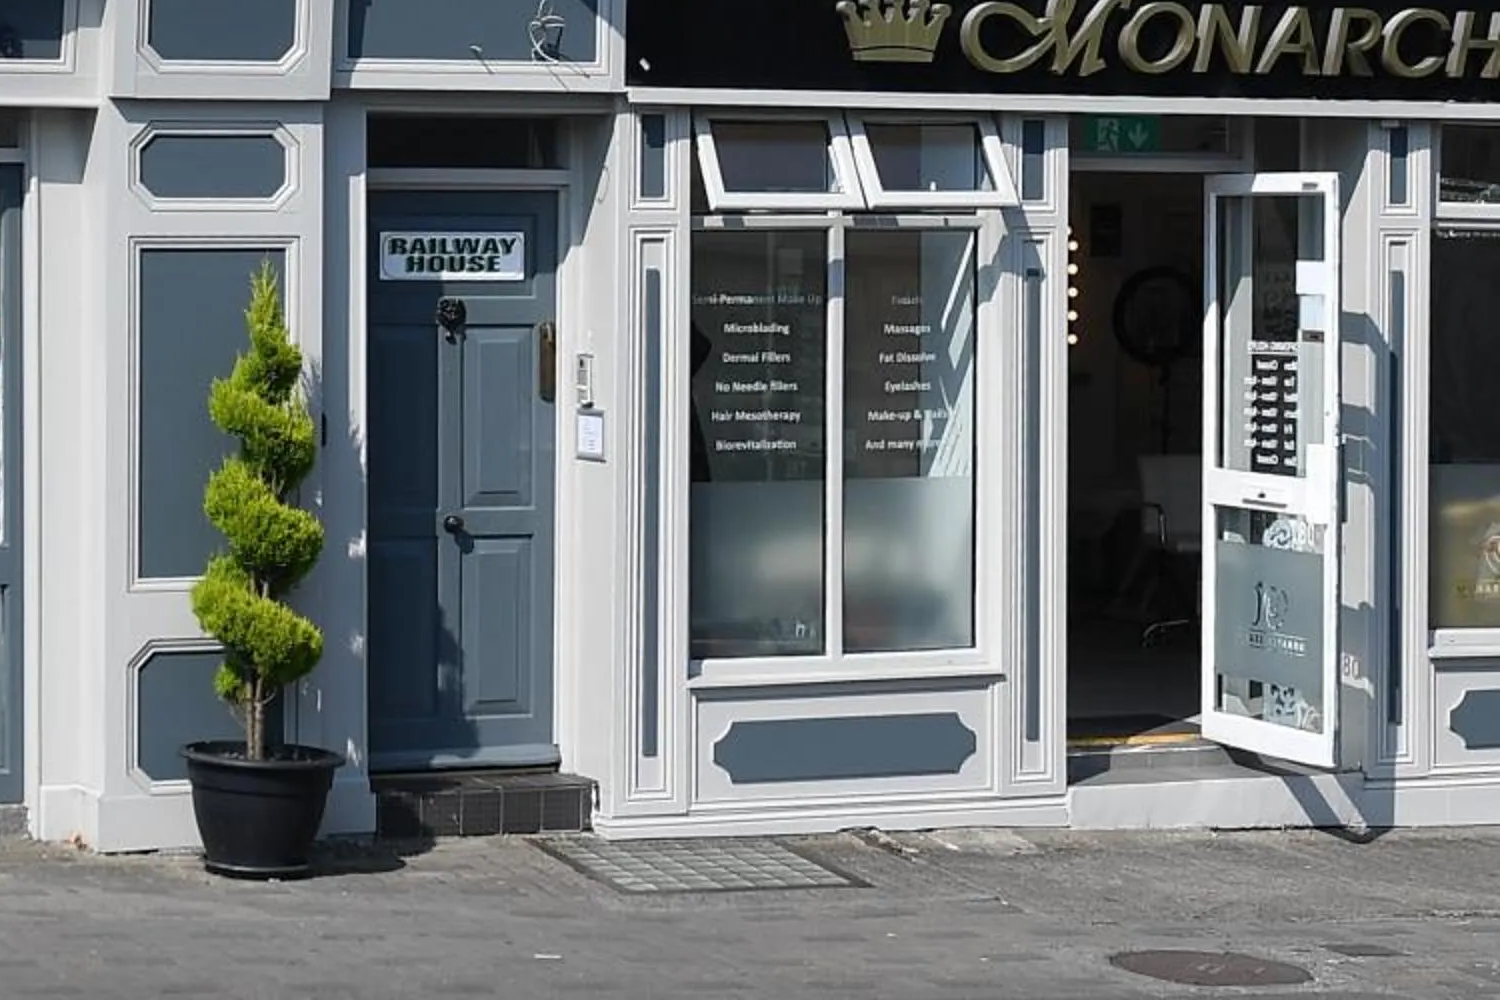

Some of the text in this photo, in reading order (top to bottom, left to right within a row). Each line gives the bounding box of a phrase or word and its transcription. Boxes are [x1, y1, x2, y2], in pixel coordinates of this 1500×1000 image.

[388, 238, 517, 255] RAILWAY
[405, 256, 501, 273] HOUSE
[723, 322, 790, 335] Microblading
[883, 323, 931, 336] Massages
[722, 352, 760, 363] Dermal
[715, 382, 731, 393] No
[732, 380, 769, 393] Needle
[884, 380, 931, 393] Eyelashes
[711, 410, 802, 423] Hair Mesotherapy
[867, 410, 912, 423] Make-up
[715, 440, 797, 452] Biorevitalization
[865, 440, 885, 451] And
[887, 440, 914, 452] many
